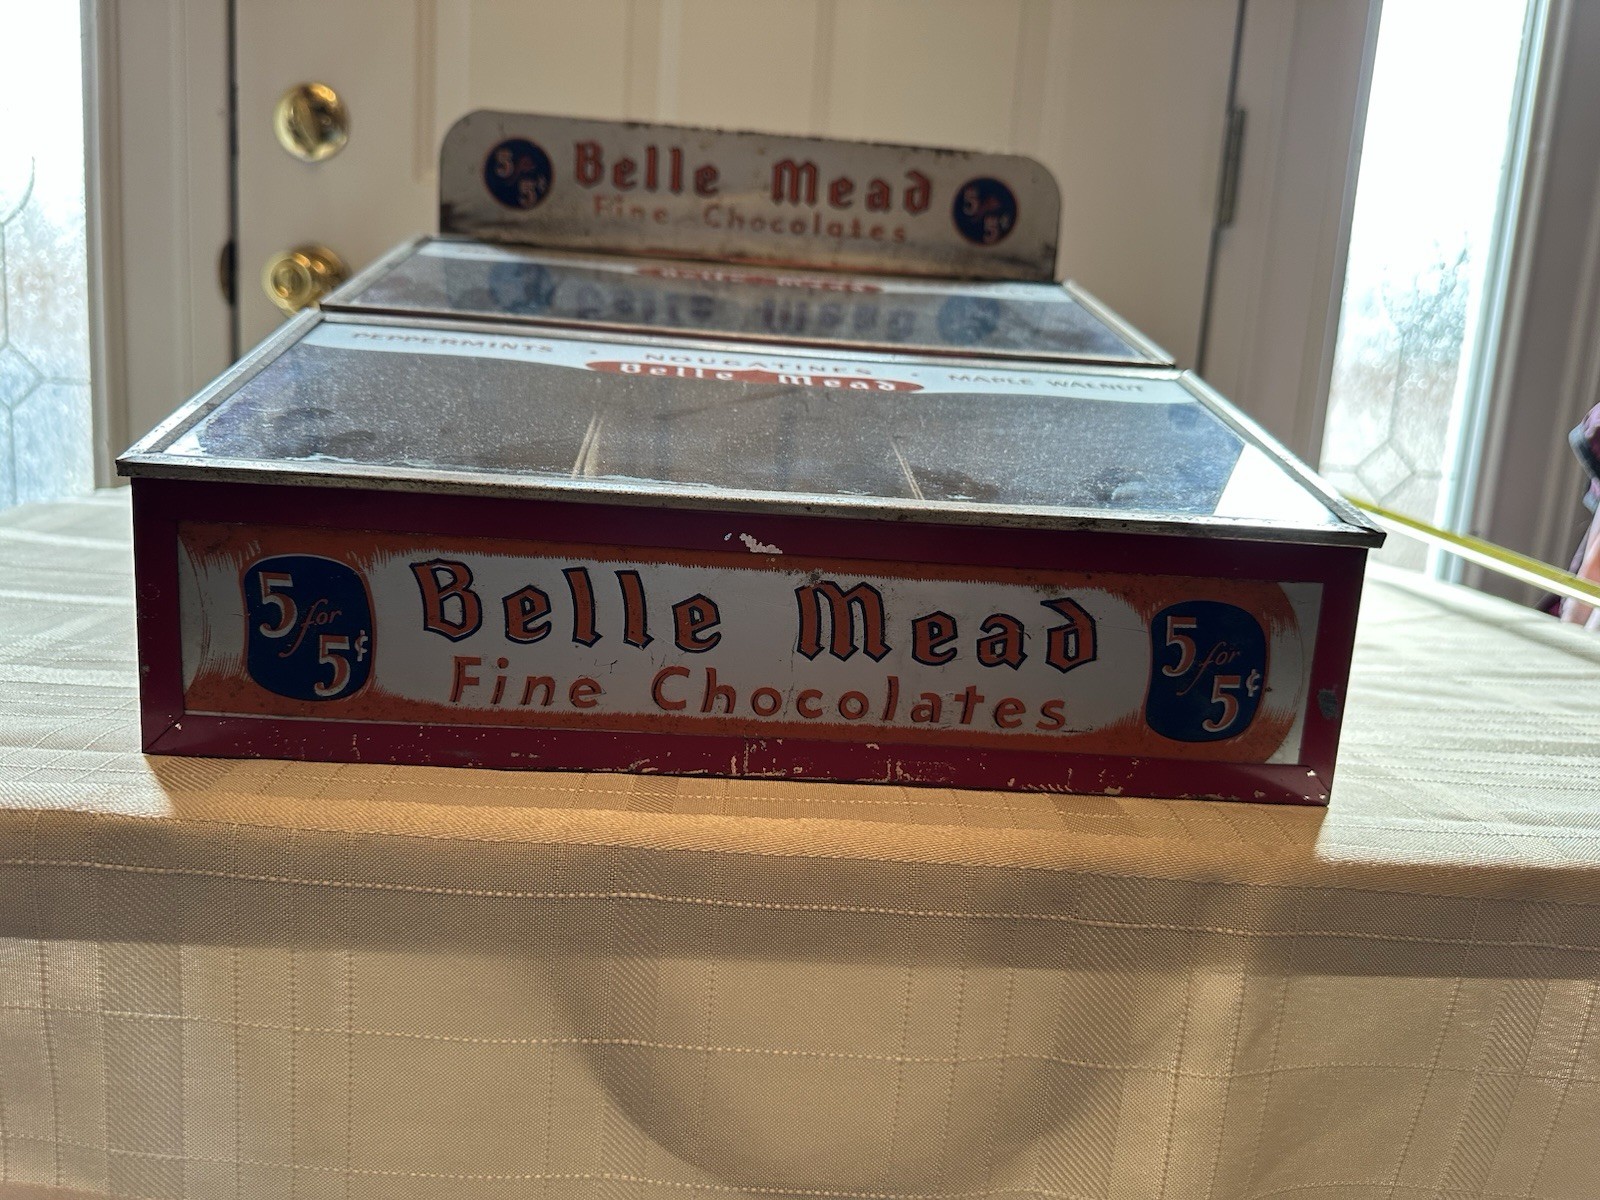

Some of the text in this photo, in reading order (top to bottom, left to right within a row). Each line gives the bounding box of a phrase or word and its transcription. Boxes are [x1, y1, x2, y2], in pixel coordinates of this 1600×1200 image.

[574, 140, 720, 196] Belle
[771, 157, 932, 213] Mead
[594, 195, 907, 244] Fine Chocolates
[353, 332, 554, 352] PEPPERMINTS
[645, 352, 872, 375] NOUGATINES
[620, 363, 734, 380] Belle
[257, 570, 343, 659] 5 for
[409, 557, 1099, 675] Belle Mead
[447, 654, 1067, 732] Fine Chocolates
[1161, 614, 1242, 697] 5 for
